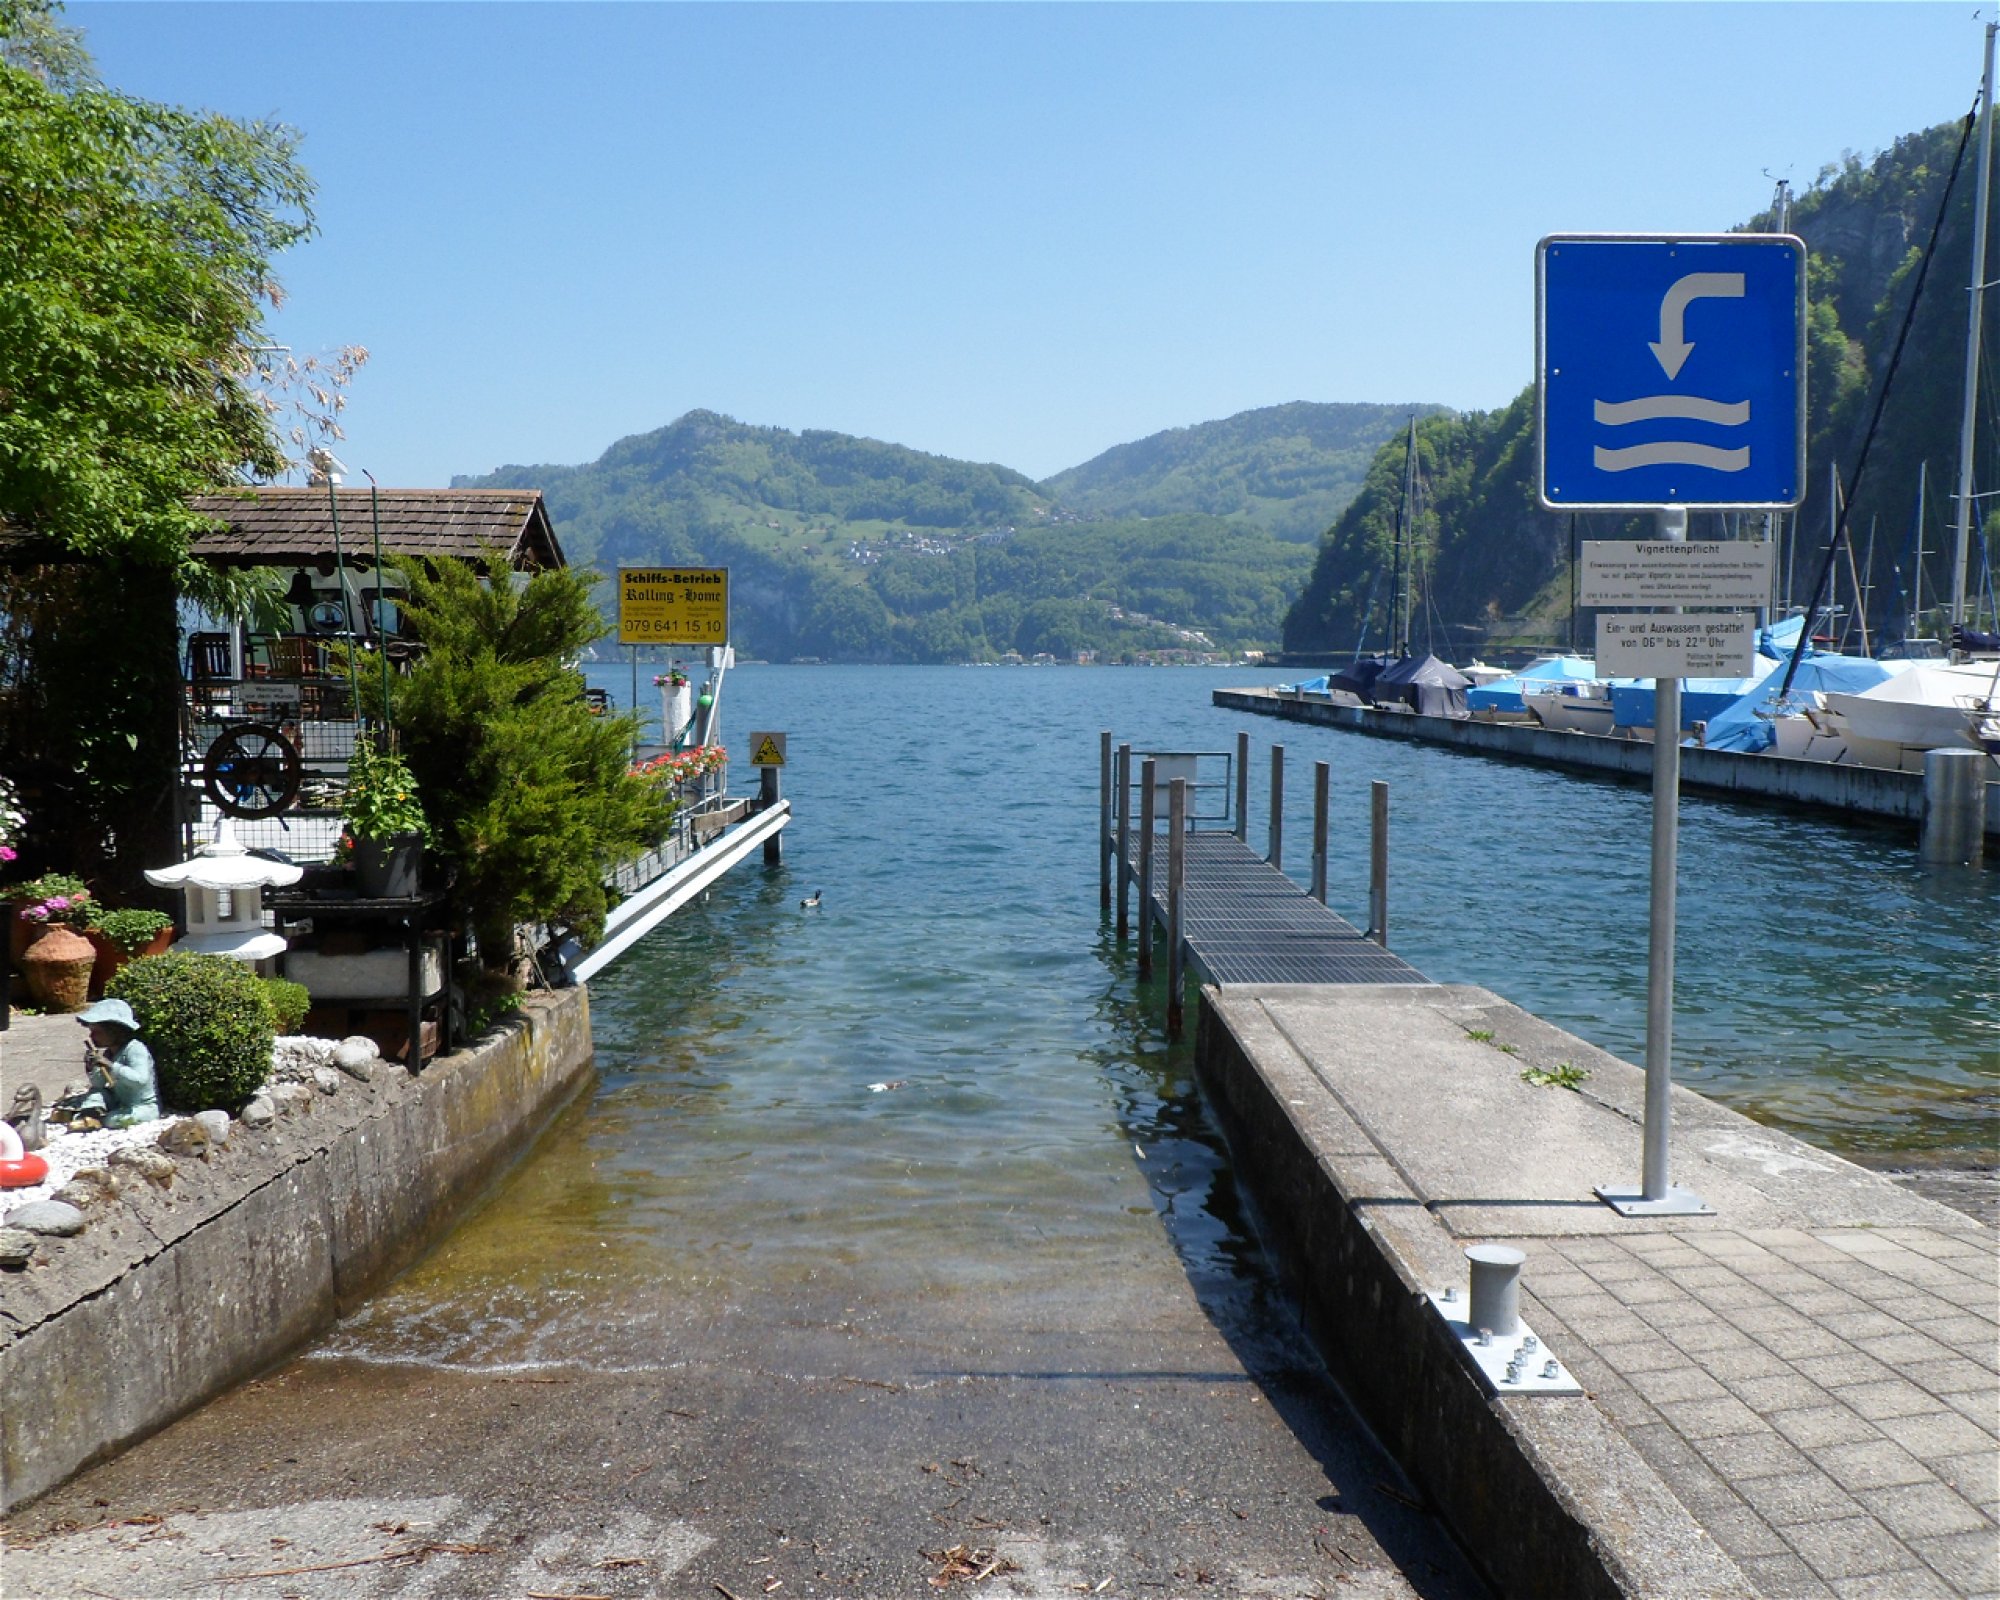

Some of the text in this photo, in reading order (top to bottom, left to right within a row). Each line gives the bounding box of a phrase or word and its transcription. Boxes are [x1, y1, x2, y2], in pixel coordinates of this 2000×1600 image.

[1636, 544, 1720, 555] Vignettenpflicht
[625, 573, 721, 584] Schiffs-Betrieb
[626, 588, 674, 604] Rolling
[625, 620, 721, 632] 079 641 15 10
[1606, 622, 1625, 634] Ein-
[1629, 622, 1646, 634] und
[1650, 622, 1701, 634] Auswassern
[1621, 640, 1637, 648] von
[1666, 637, 1681, 648] bis
[1708, 637, 1726, 648] Uhr
